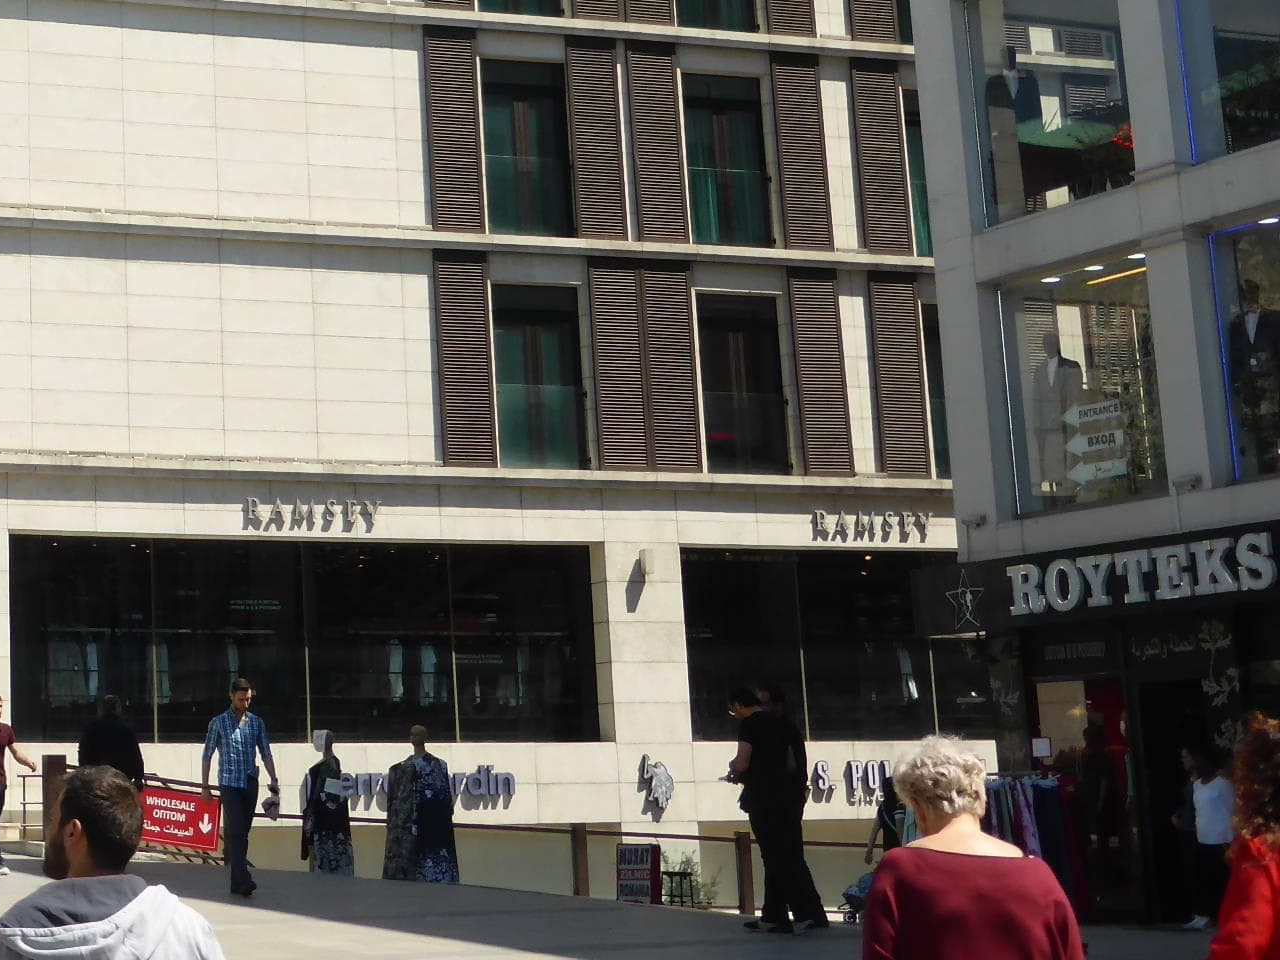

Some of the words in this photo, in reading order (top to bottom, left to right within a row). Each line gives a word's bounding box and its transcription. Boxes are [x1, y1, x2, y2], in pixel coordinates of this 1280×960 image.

[1078, 403, 1119, 419] ENTRANCE
[1087, 432, 1117, 448] ВХОД
[247, 496, 383, 524] RAMSEY
[813, 510, 934, 534] RAMSEY
[1006, 532, 1278, 616] ROYTEKS
[146, 795, 196, 812] WHOLESALE
[153, 808, 185, 822] ОПТОМ
